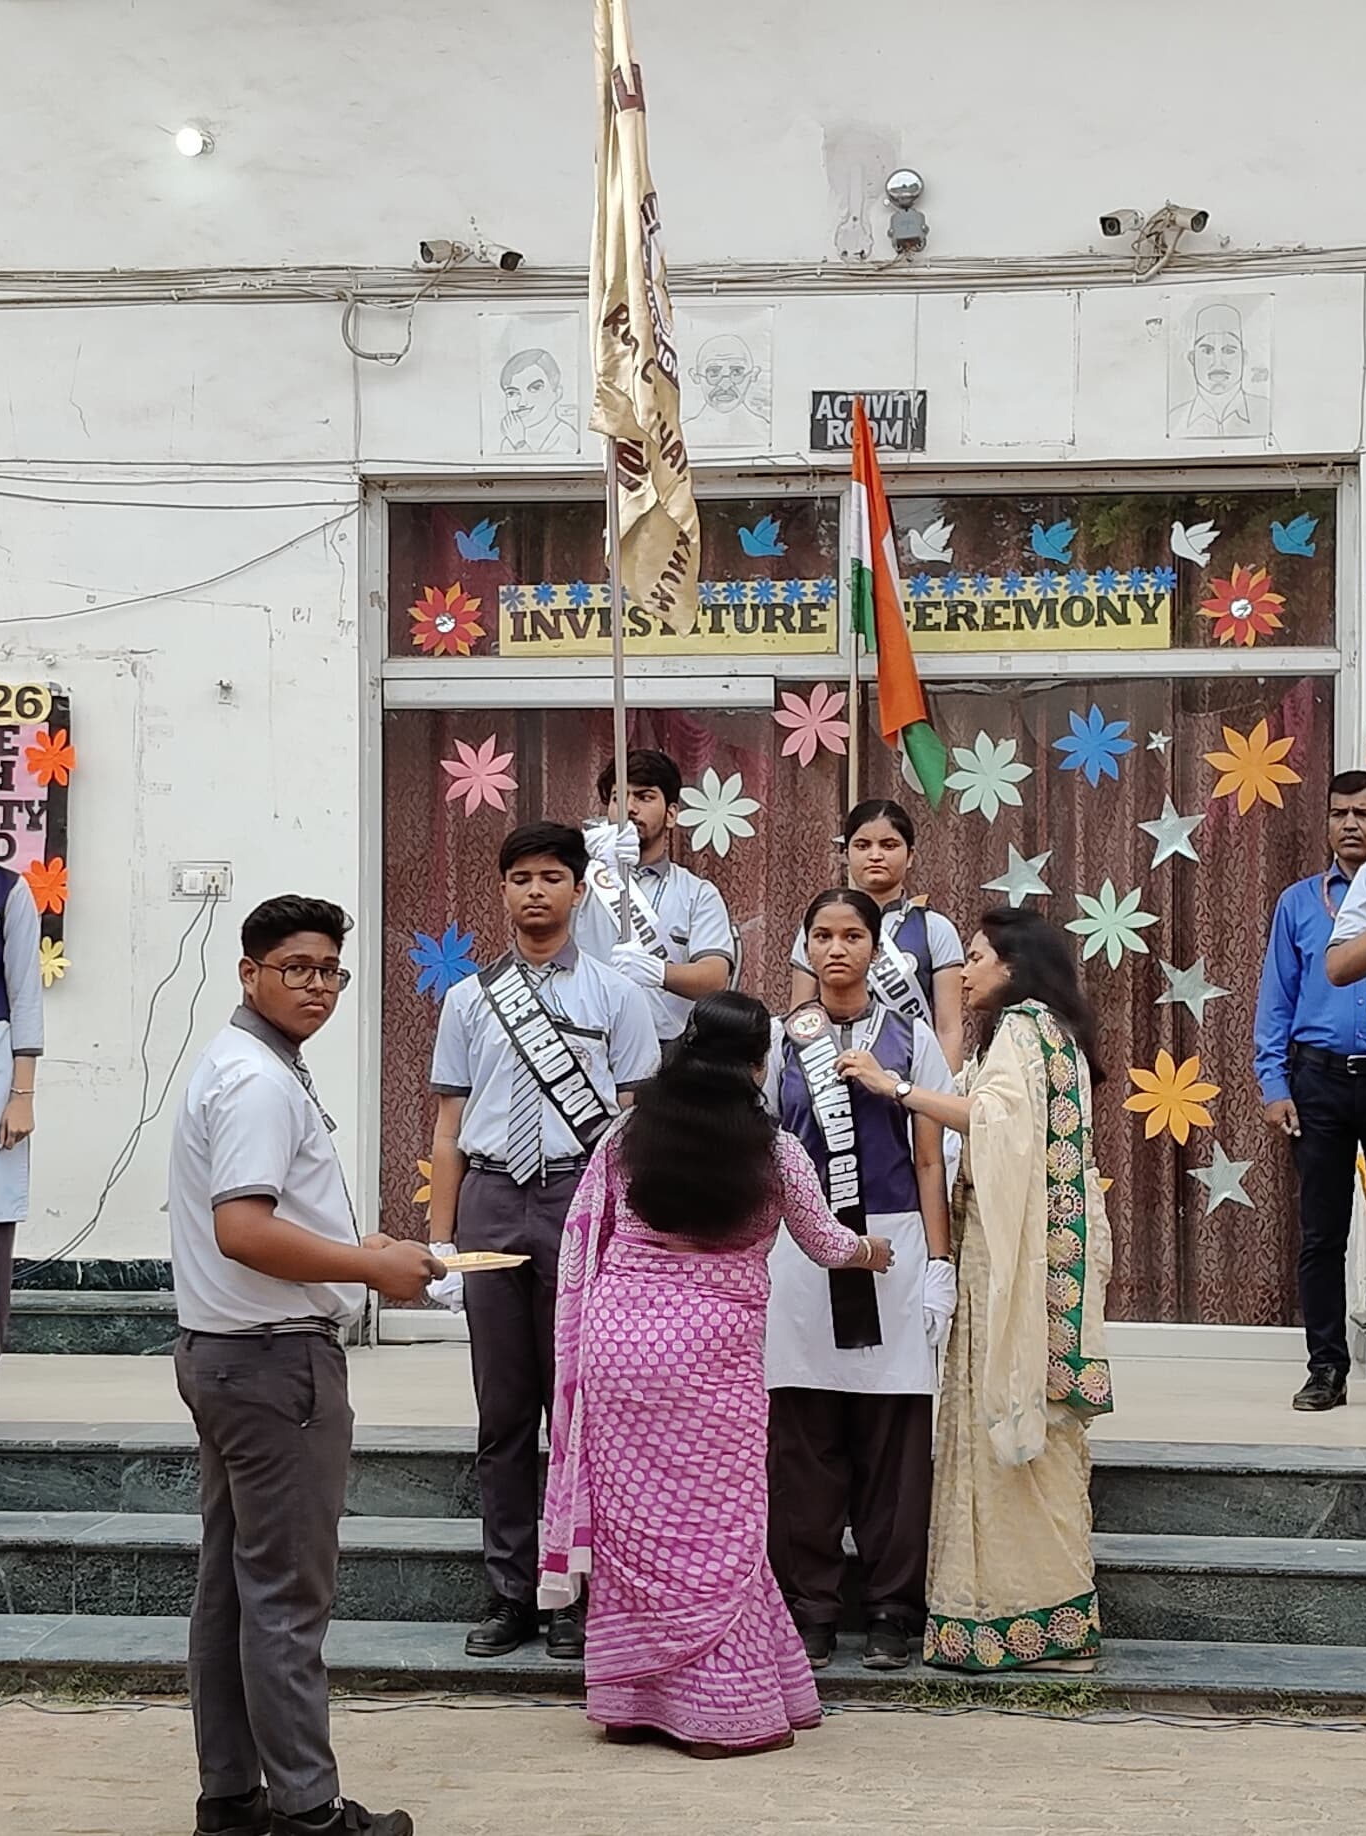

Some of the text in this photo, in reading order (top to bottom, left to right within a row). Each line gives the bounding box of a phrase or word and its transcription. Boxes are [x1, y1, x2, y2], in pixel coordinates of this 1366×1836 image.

[510, 602, 831, 642] INVESTURE
[870, 941, 911, 1001] EAD
[488, 963, 604, 1128] VICE HEAD BOY
[814, 1084, 856, 1153] HEAD
[827, 1153, 860, 1214] GIRL
